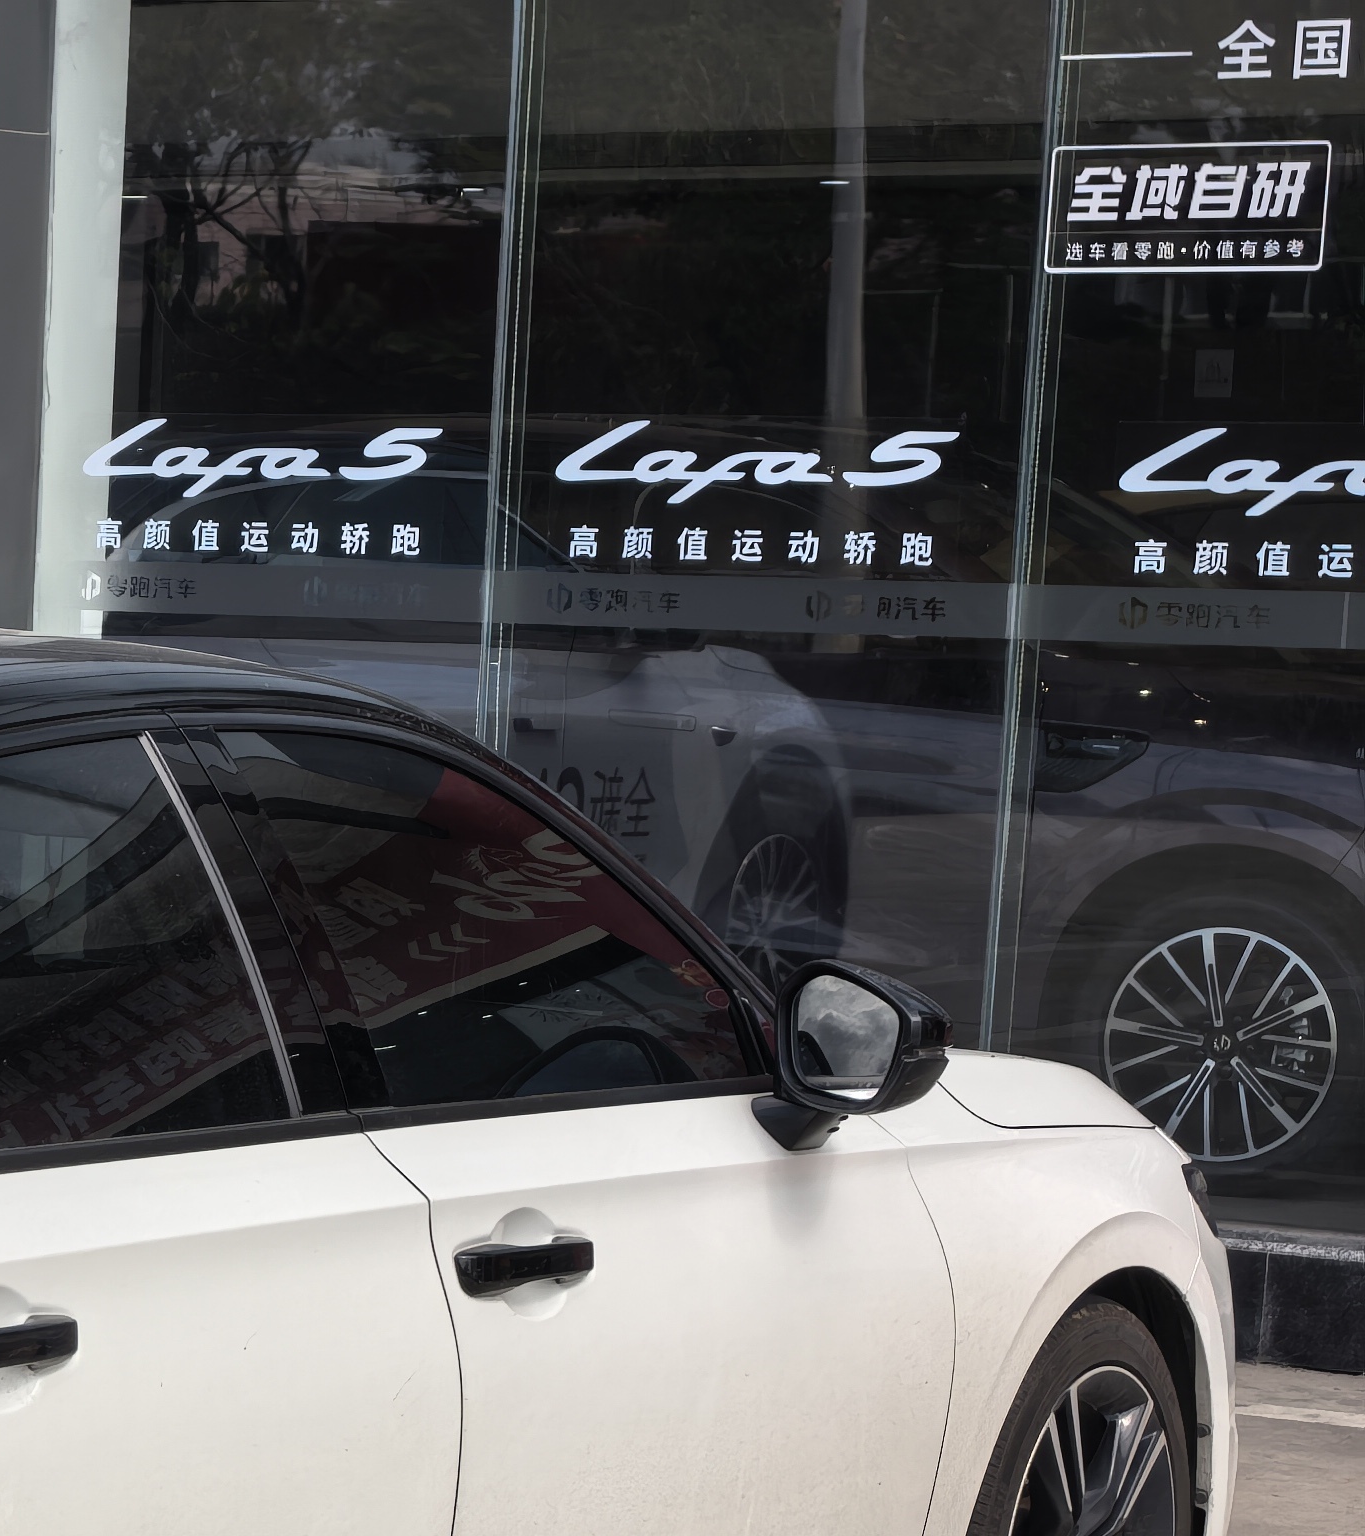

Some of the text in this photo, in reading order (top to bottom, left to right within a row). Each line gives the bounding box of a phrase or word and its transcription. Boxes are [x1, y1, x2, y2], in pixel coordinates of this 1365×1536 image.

[1217, 18, 1352, 80] 全国
[1066, 161, 1311, 222] 全域自研
[338, 427, 443, 481] 5
[842, 430, 960, 489] 5
[95, 518, 421, 557] 高颜值运动轿跑
[569, 524, 934, 567] 高颜值运动轿跑
[1133, 538, 1354, 578] 高颜值运
